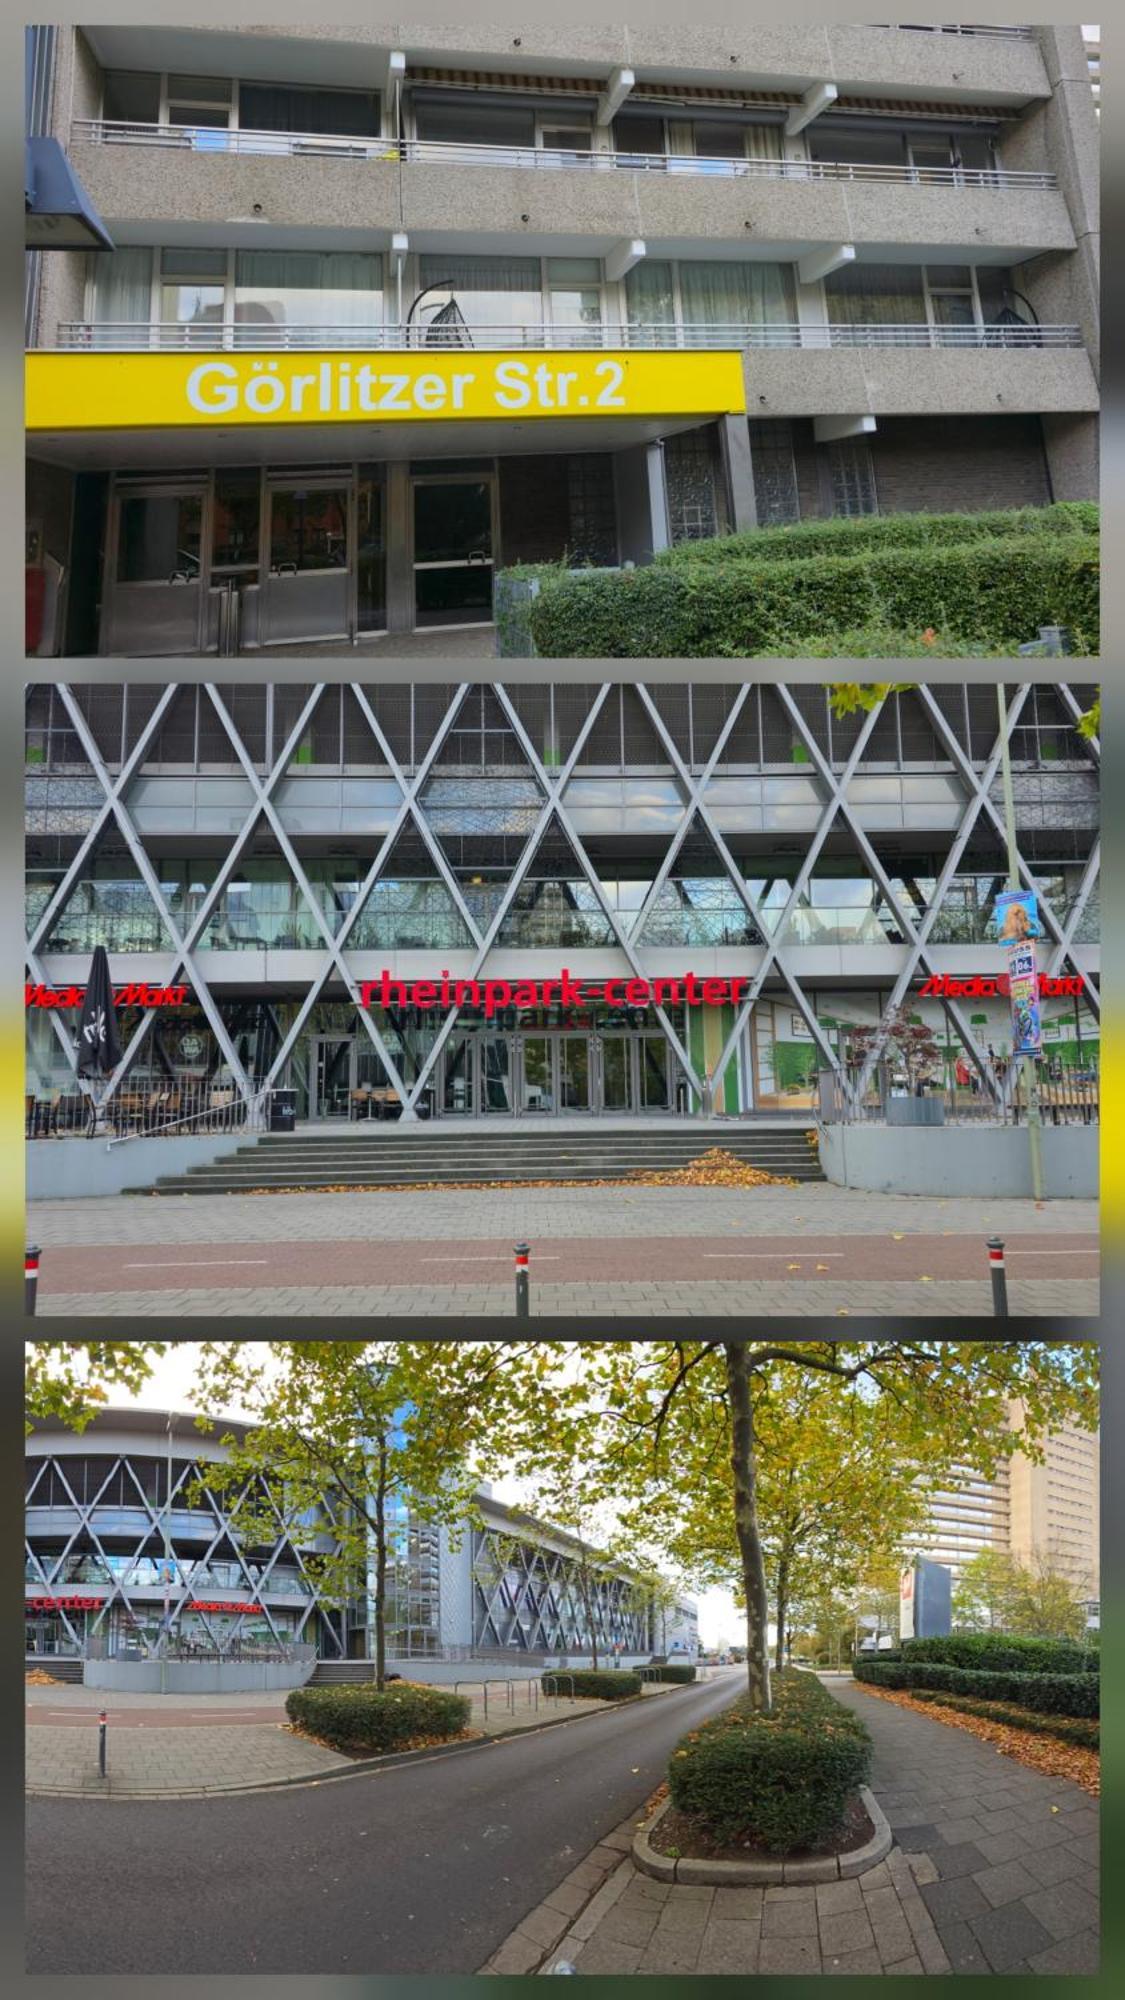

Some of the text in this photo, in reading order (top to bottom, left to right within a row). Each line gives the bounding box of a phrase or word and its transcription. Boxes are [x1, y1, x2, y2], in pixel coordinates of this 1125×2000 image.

[185, 360, 627, 415] Görlitzer Str.2
[361, 969, 748, 1019] rheinpark-center
